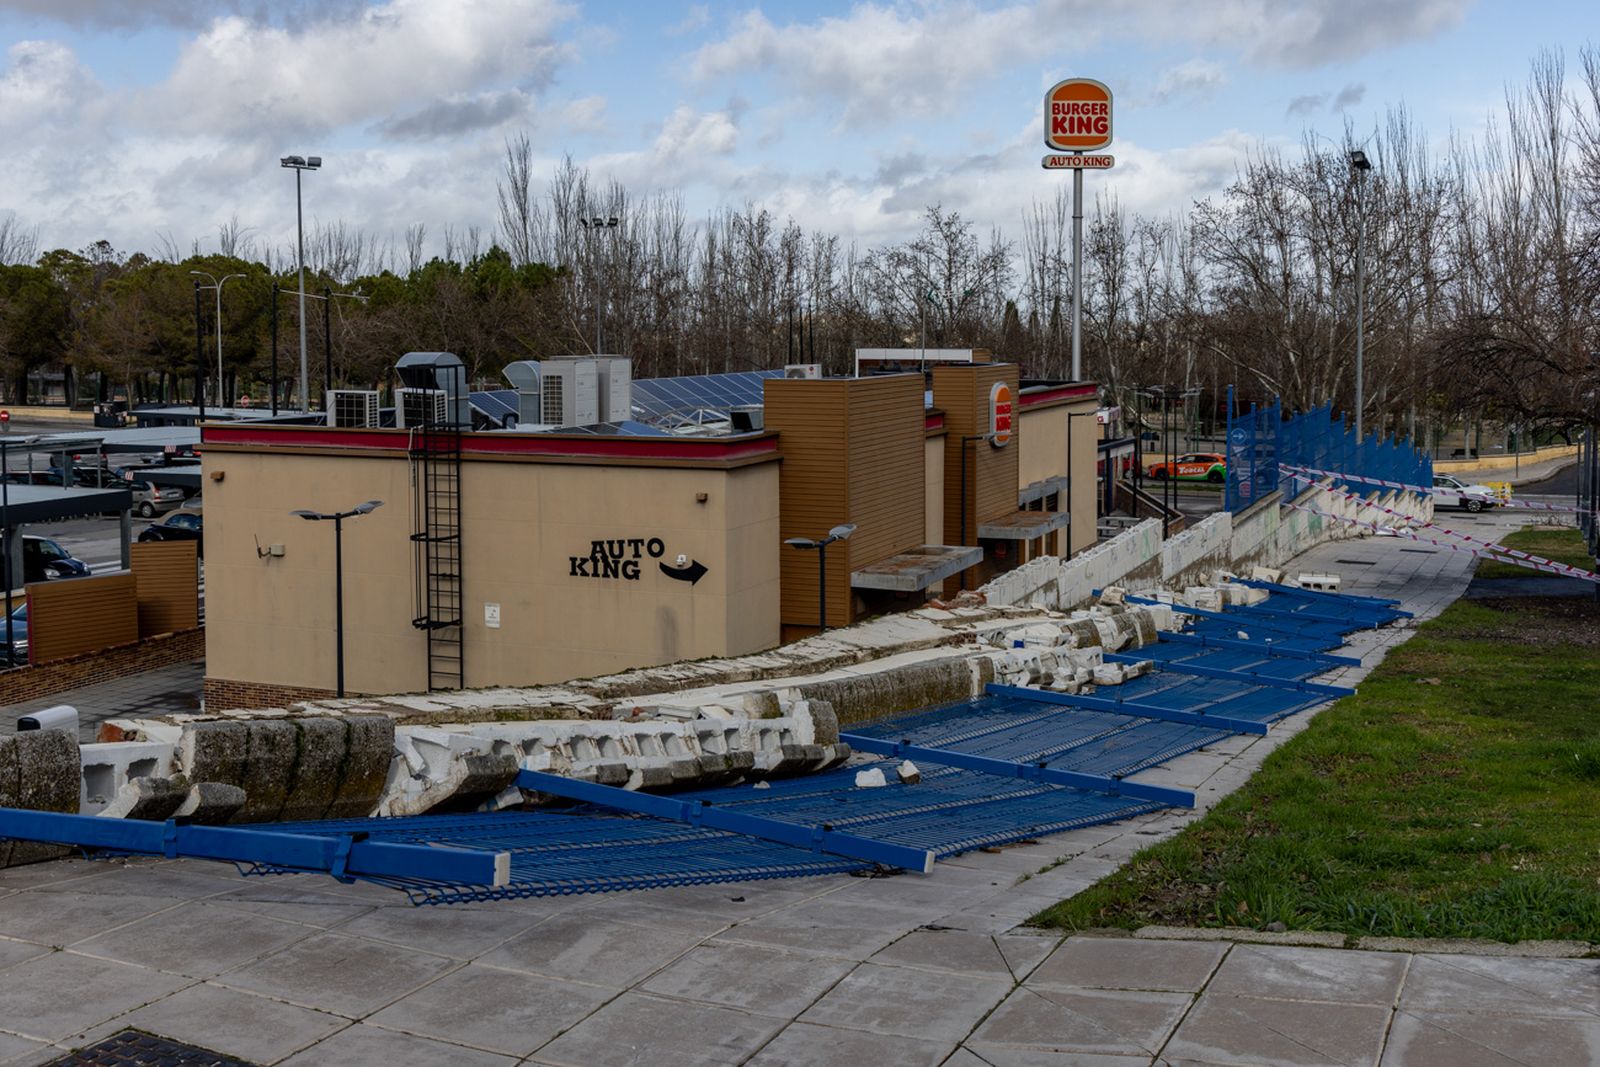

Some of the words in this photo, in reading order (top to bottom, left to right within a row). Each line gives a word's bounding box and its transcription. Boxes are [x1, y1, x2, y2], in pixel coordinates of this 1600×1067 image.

[1051, 102, 1109, 115] BURGER
[1051, 116, 1109, 134] KING
[1049, 157, 1081, 167] AUTO
[1083, 157, 1111, 167] KING
[589, 537, 665, 562] AUTO
[569, 556, 641, 580] KING
